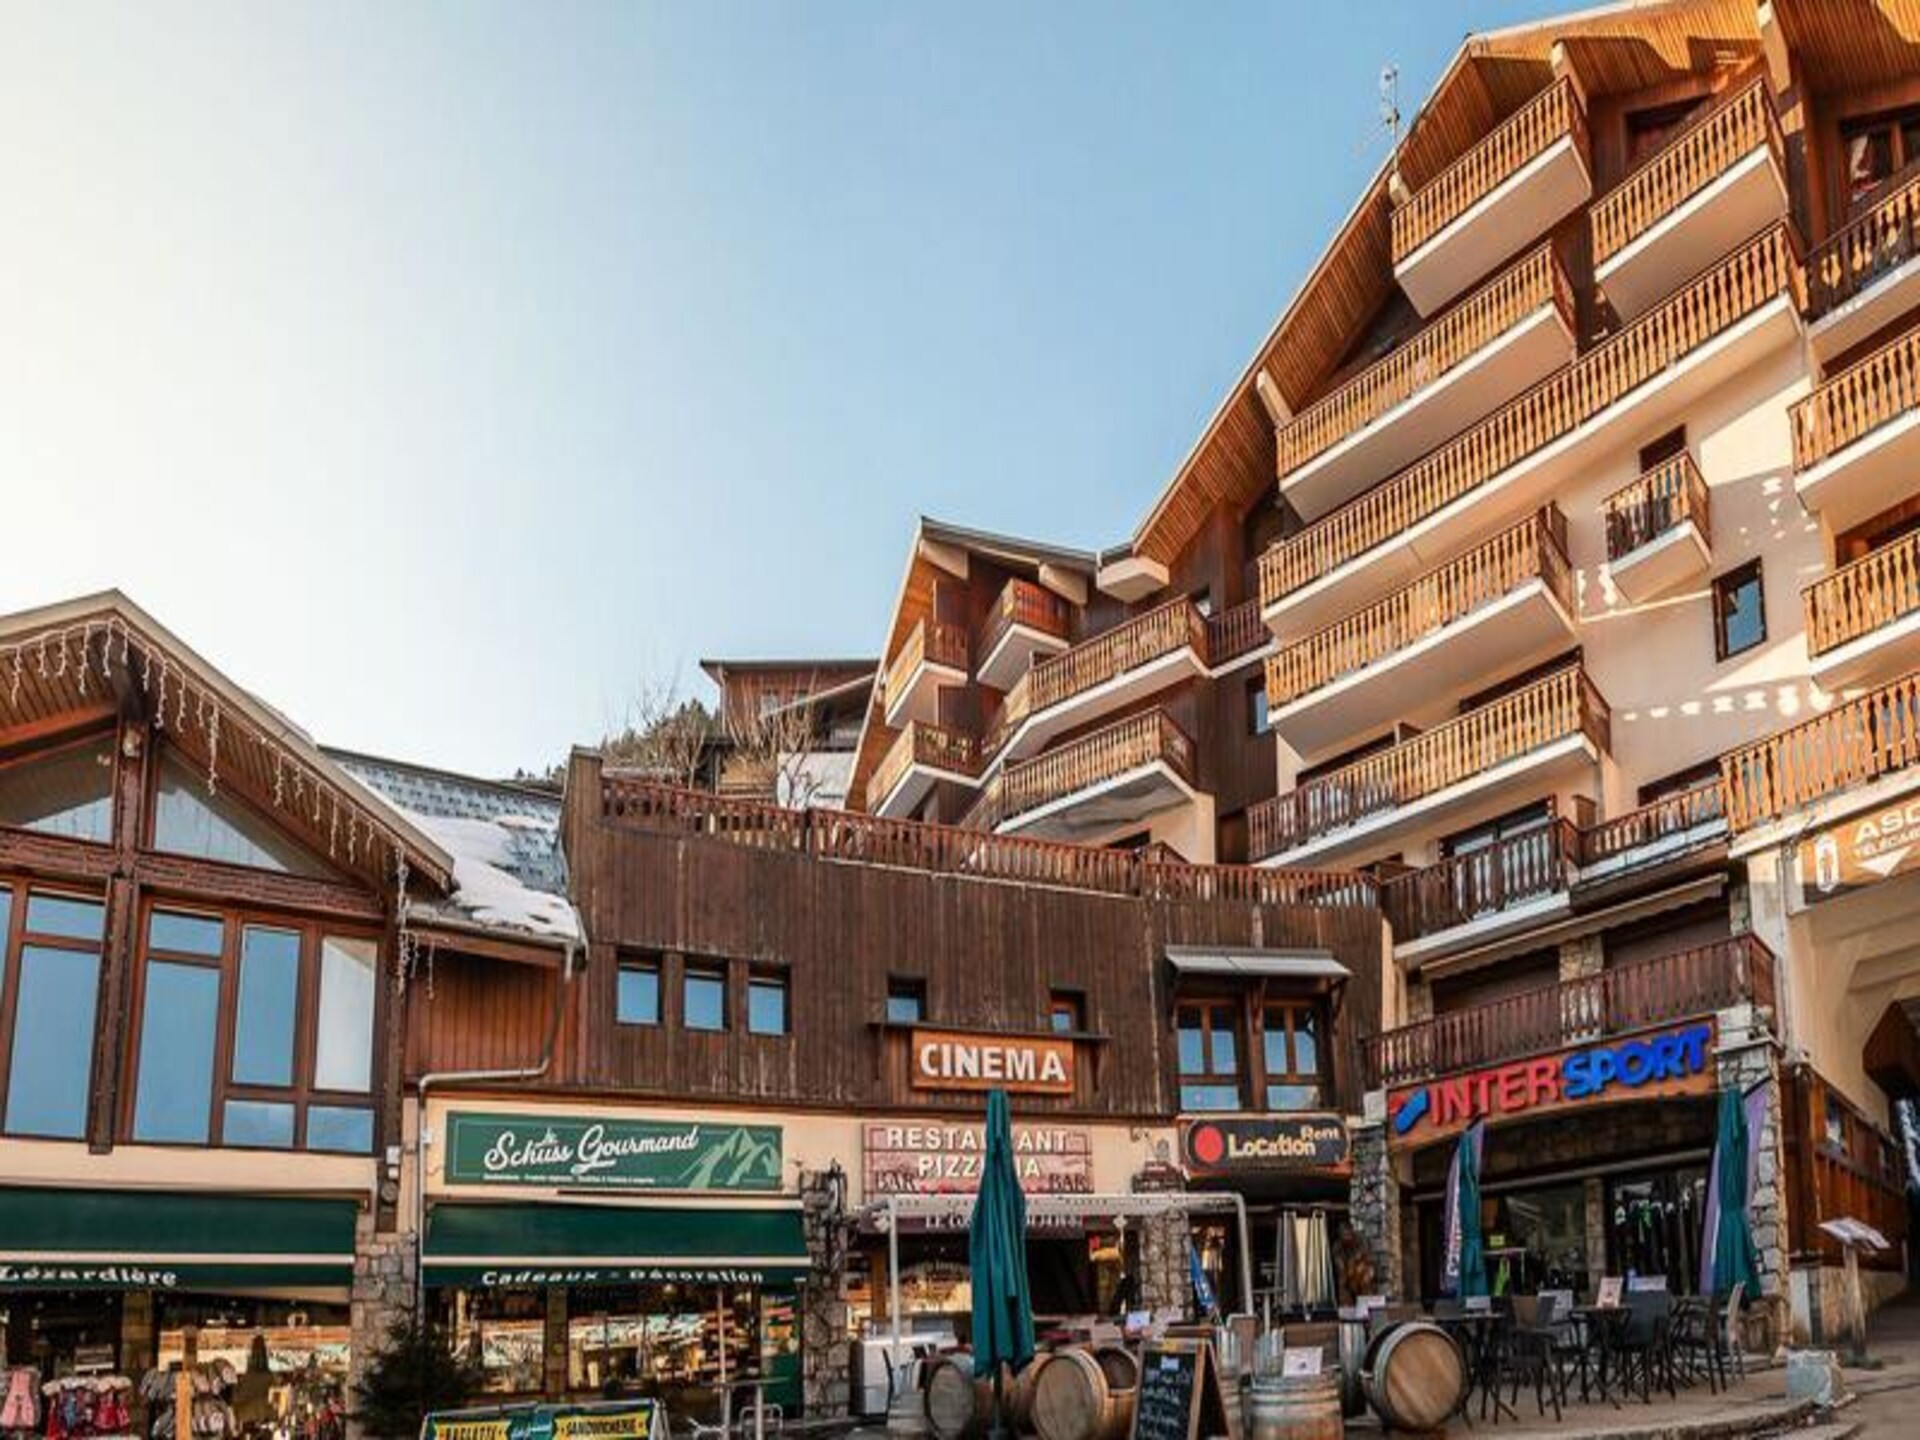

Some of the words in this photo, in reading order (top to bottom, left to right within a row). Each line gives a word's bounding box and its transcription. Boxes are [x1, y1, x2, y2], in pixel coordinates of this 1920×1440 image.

[920, 1043, 1067, 1081] CINEMA
[1428, 1024, 1710, 1127] INTERSPORT
[886, 1126, 1068, 1152] RESTAANT
[1300, 1125, 1340, 1141] Rent
[484, 1131, 573, 1171] Schuss
[570, 1124, 699, 1175] Gourmand
[918, 1154, 1041, 1179] PIZZIA
[481, 1271, 599, 1286] Cadeaux
[629, 1268, 764, 1284] Décoration
